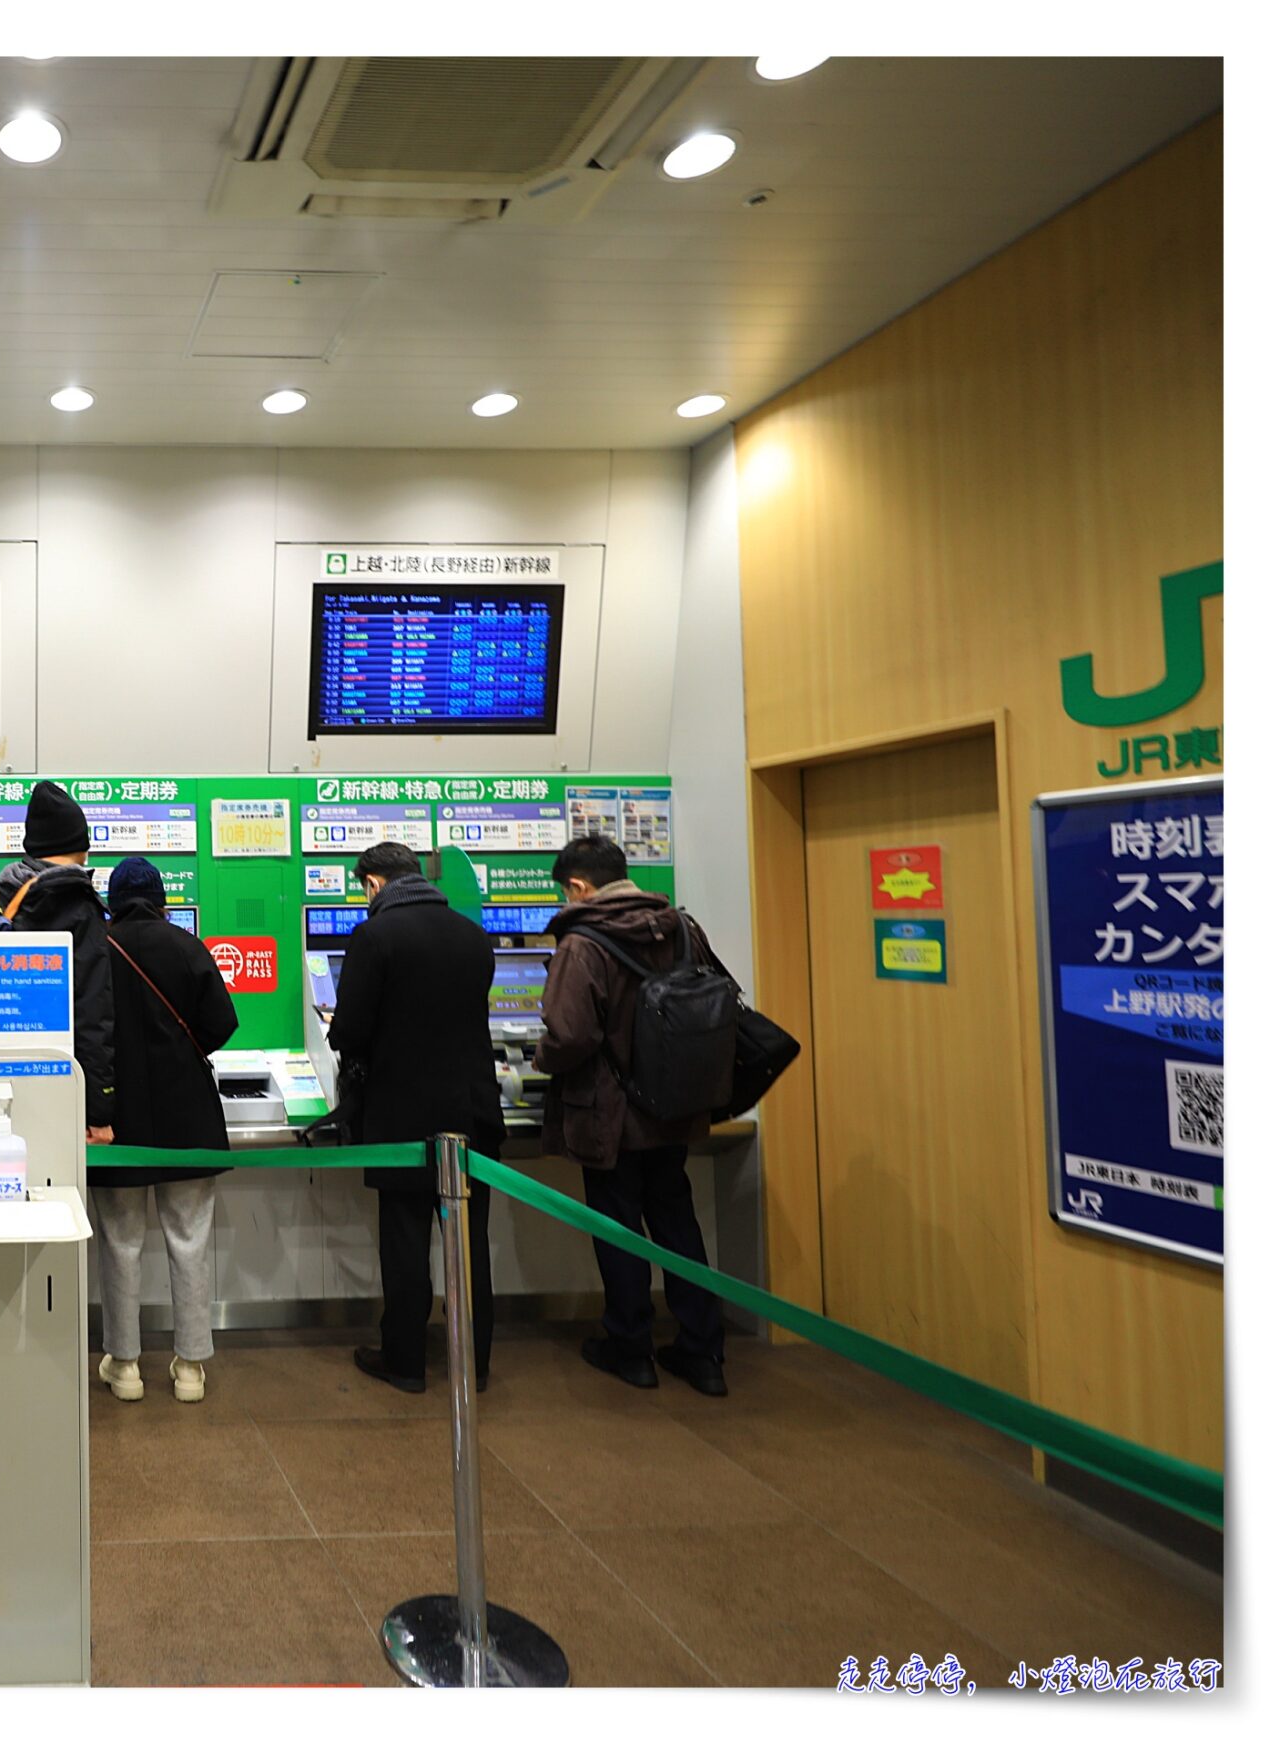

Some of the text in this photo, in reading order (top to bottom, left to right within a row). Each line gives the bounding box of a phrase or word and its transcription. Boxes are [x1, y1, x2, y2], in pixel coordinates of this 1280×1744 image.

[1060, 560, 1224, 729] J
[1098, 726, 1224, 778] JR東
[78, 781, 105, 791] 指定席
[78, 792, 105, 800] 自由席
[112, 826, 137, 834] 新幹線
[348, 826, 373, 834] 新幹線
[484, 825, 508, 833] 新幹線
[490, 868, 552, 878] 各種クレジットカー
[246, 951, 272, 959] JR-EAST
[246, 960, 271, 968] RAIL
[246, 969, 272, 978] PASS
[1, 978, 12, 986] the
[14, 978, 32, 986] hand
[34, 978, 63, 986] sanitizer.
[1077, 1160, 1200, 1201] JR東日本 時刻表
[1067, 1188, 1103, 1216] JR
